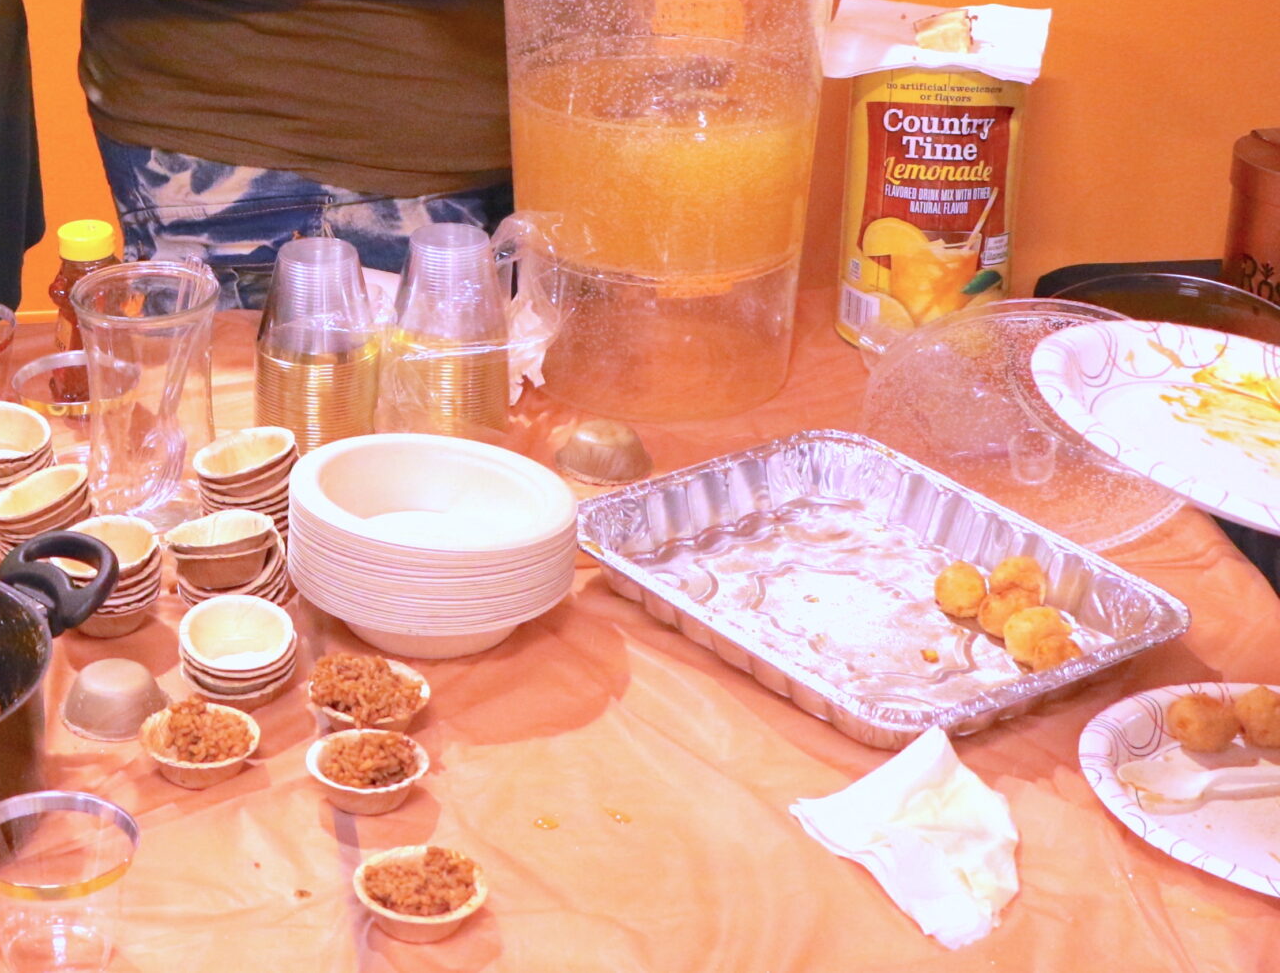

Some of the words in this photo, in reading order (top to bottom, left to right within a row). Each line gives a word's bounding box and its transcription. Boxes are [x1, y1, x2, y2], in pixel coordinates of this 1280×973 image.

[886, 82, 898, 90] no
[900, 82, 948, 92] artificial
[935, 93, 972, 103] flavors
[883, 108, 996, 140] Country
[902, 136, 978, 162] Time
[883, 156, 993, 186] Lemonade
[884, 184, 917, 200] FLAVORED
[918, 187, 940, 201] DRINK
[941, 188, 955, 202] MIX
[955, 188, 972, 201] WITH
[973, 187, 991, 200] OTHER
[910, 201, 942, 214] NATURAL
[943, 201, 969, 214] FLAVOR
